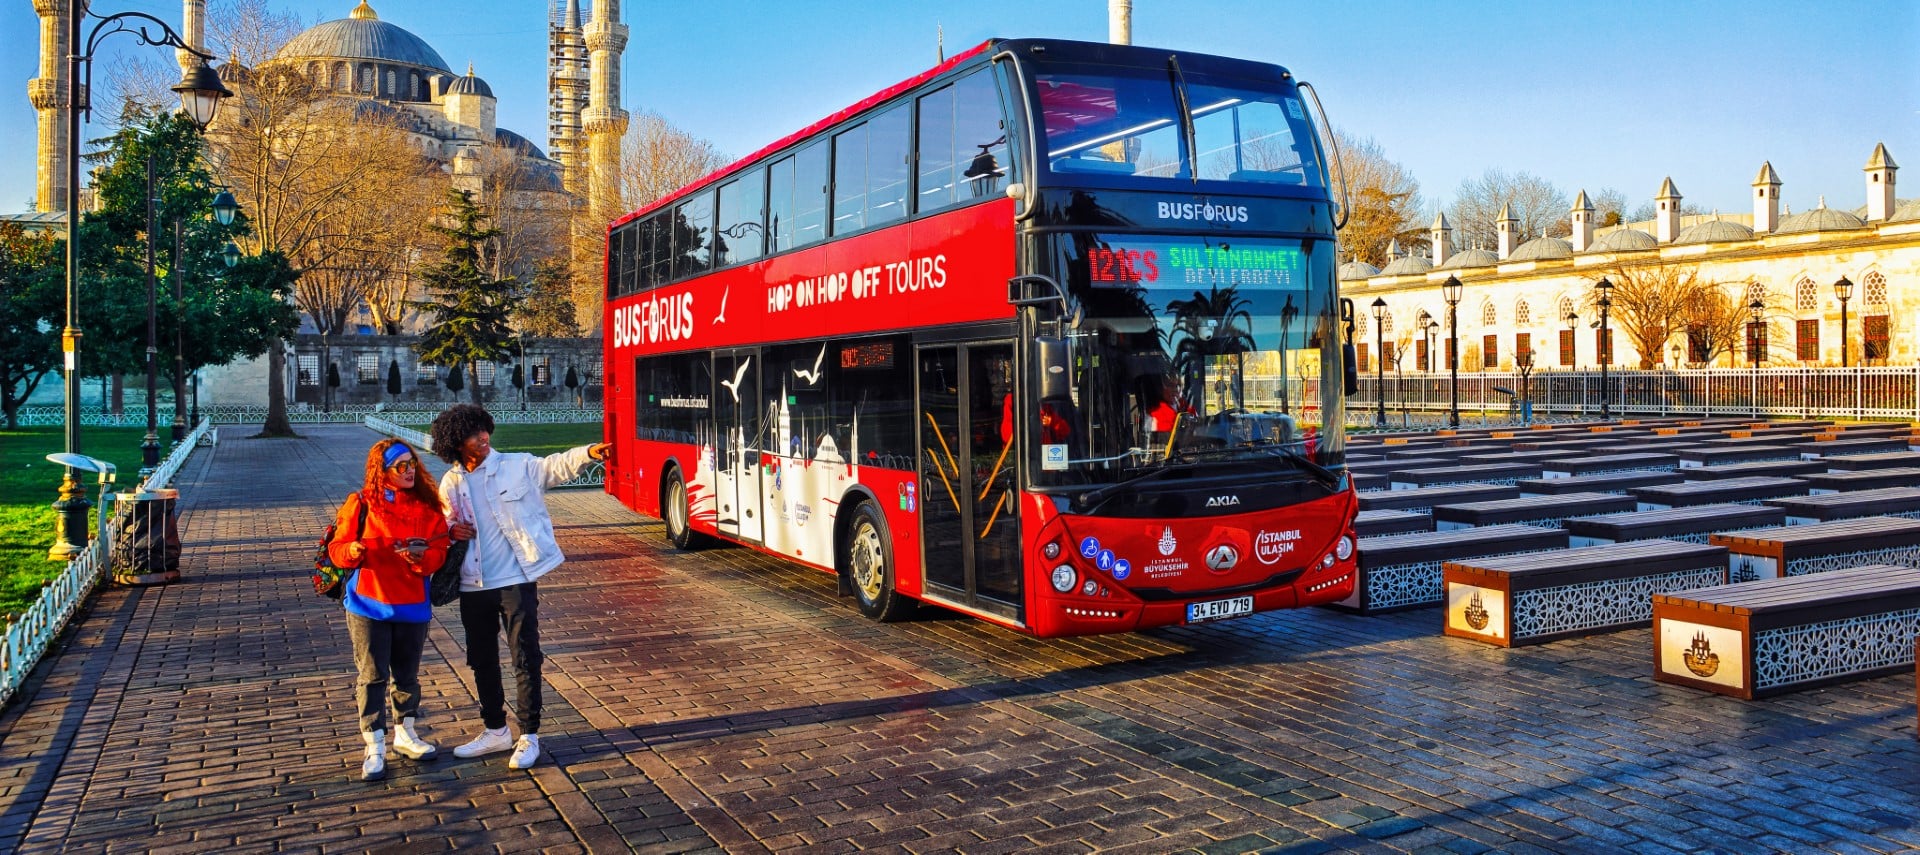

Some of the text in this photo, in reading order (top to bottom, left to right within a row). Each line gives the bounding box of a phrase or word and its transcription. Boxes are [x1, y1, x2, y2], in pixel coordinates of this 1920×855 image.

[1158, 201, 1248, 223] BUSFORUS
[1088, 247, 1298, 282] 121CS SULTANAHMET
[768, 254, 947, 314] HOP ON HOP OFF TOURS
[614, 291, 694, 349] BUSFORUS
[1205, 495, 1241, 507] AKIA
[1193, 604, 1206, 618] 34
[1232, 598, 1250, 613] 719
